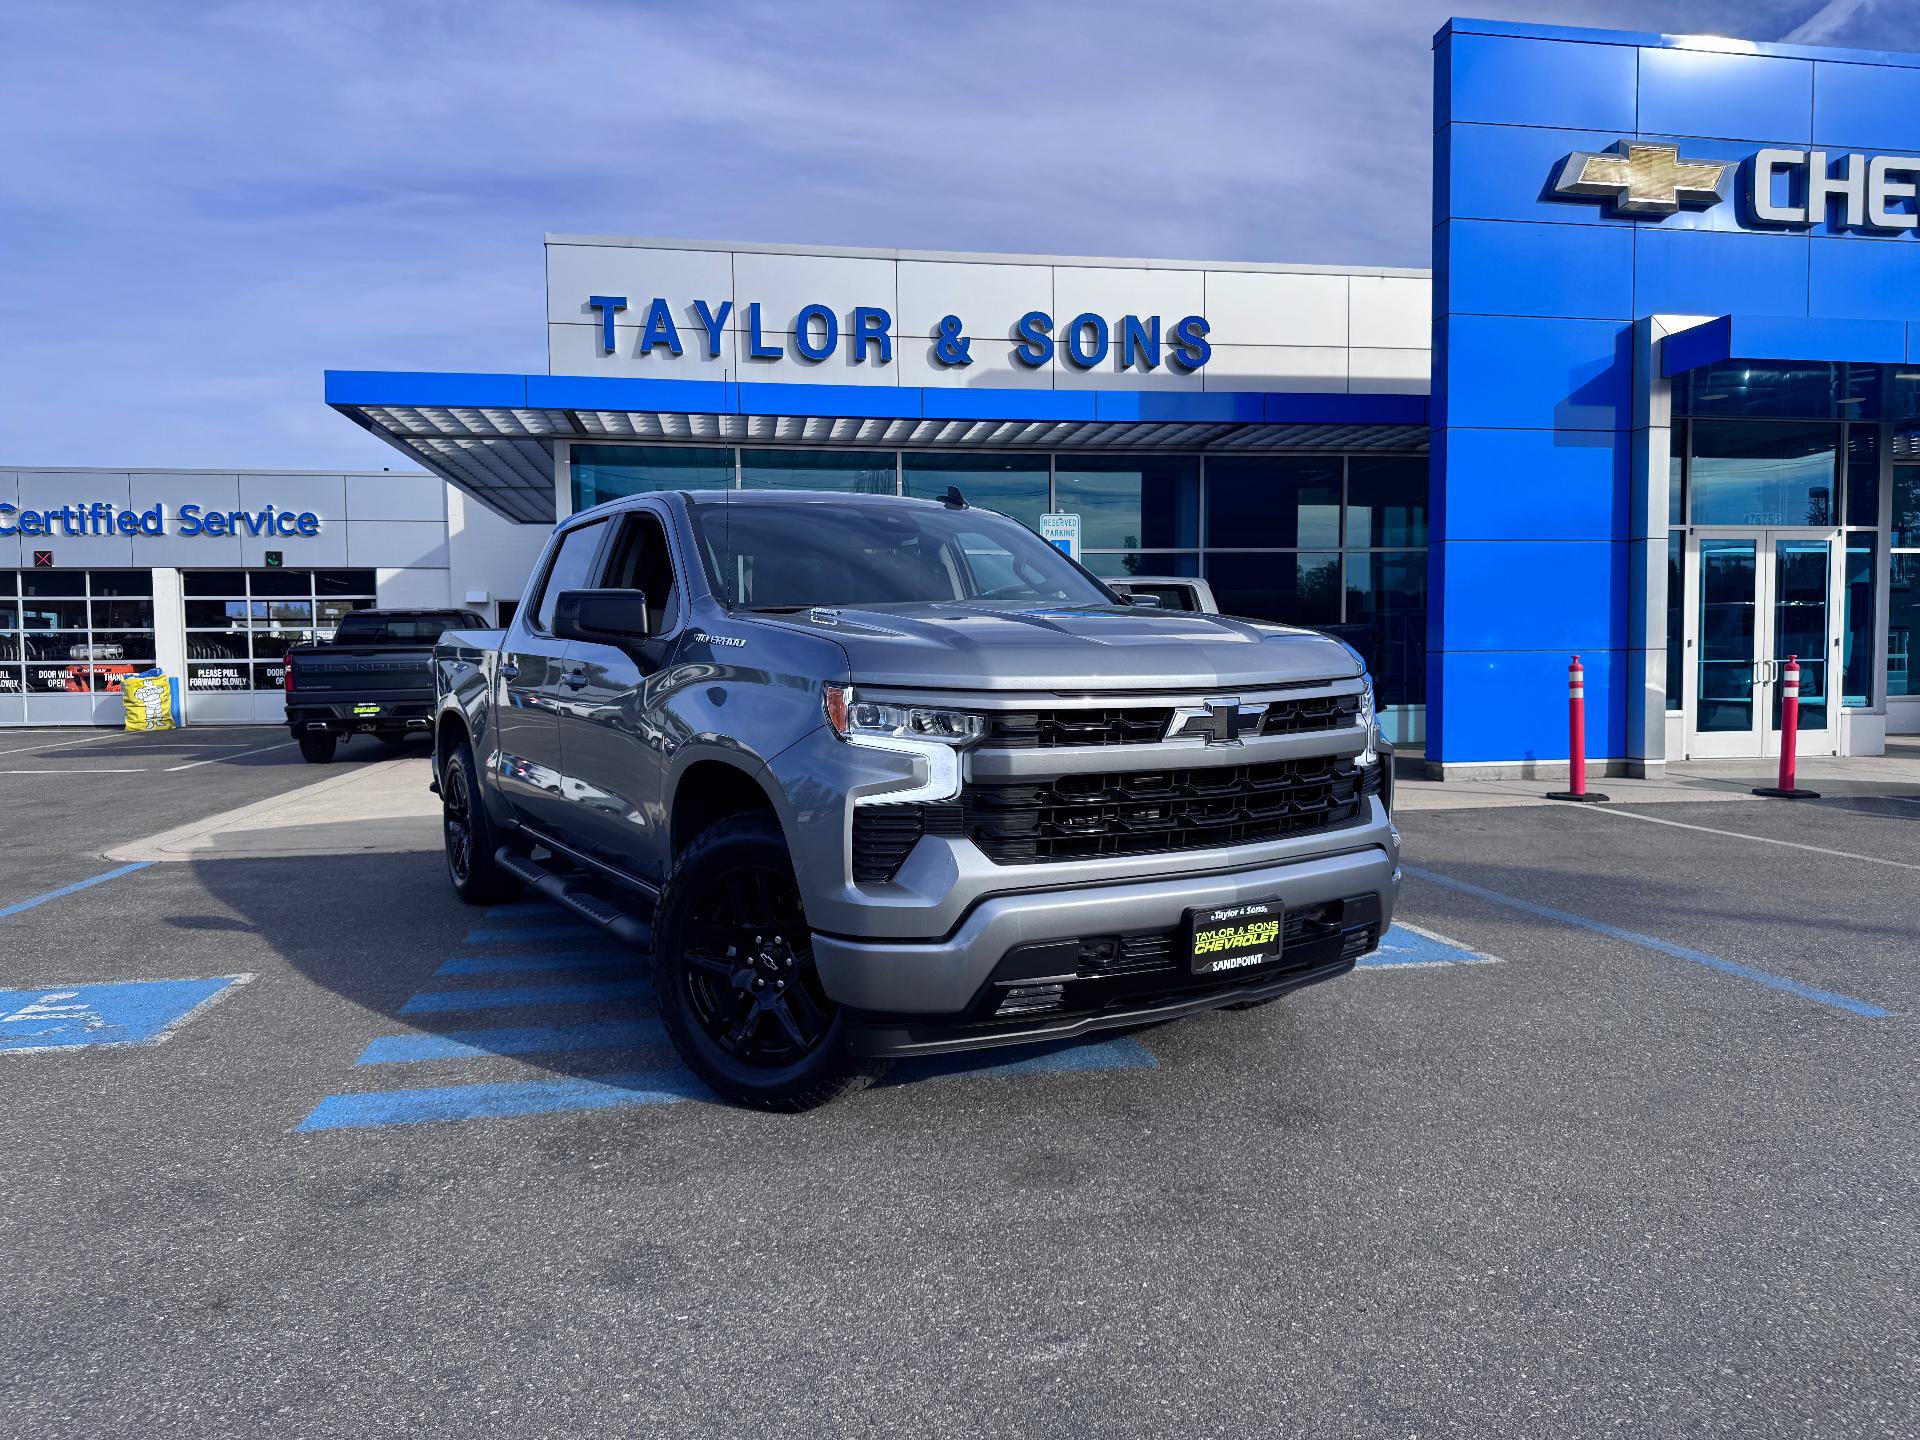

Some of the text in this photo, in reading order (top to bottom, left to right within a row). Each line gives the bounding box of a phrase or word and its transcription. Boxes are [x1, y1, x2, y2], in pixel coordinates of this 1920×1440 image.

[1755, 149, 1920, 228] CHE
[590, 296, 1212, 369] TAYLOR & SONS
[0, 503, 319, 536] Certified Service
[1043, 518, 1077, 527] RESERVED
[1045, 529, 1075, 537] PARKING
[197, 668, 239, 678] PLEASE PULL
[302, 663, 424, 673] CHEVROLET
[38, 670, 56, 678] DOOR
[58, 670, 74, 678] WILL
[48, 680, 65, 688] OPEN
[189, 678, 247, 687] FORWARD SLOWLY
[275, 677, 285, 685] OP
[1214, 909, 1238, 920] Taylor
[1195, 920, 1278, 942] TAYLOR & SONS
[1194, 930, 1279, 954] CHEVROLET
[1212, 953, 1263, 971] SANDPOINT
